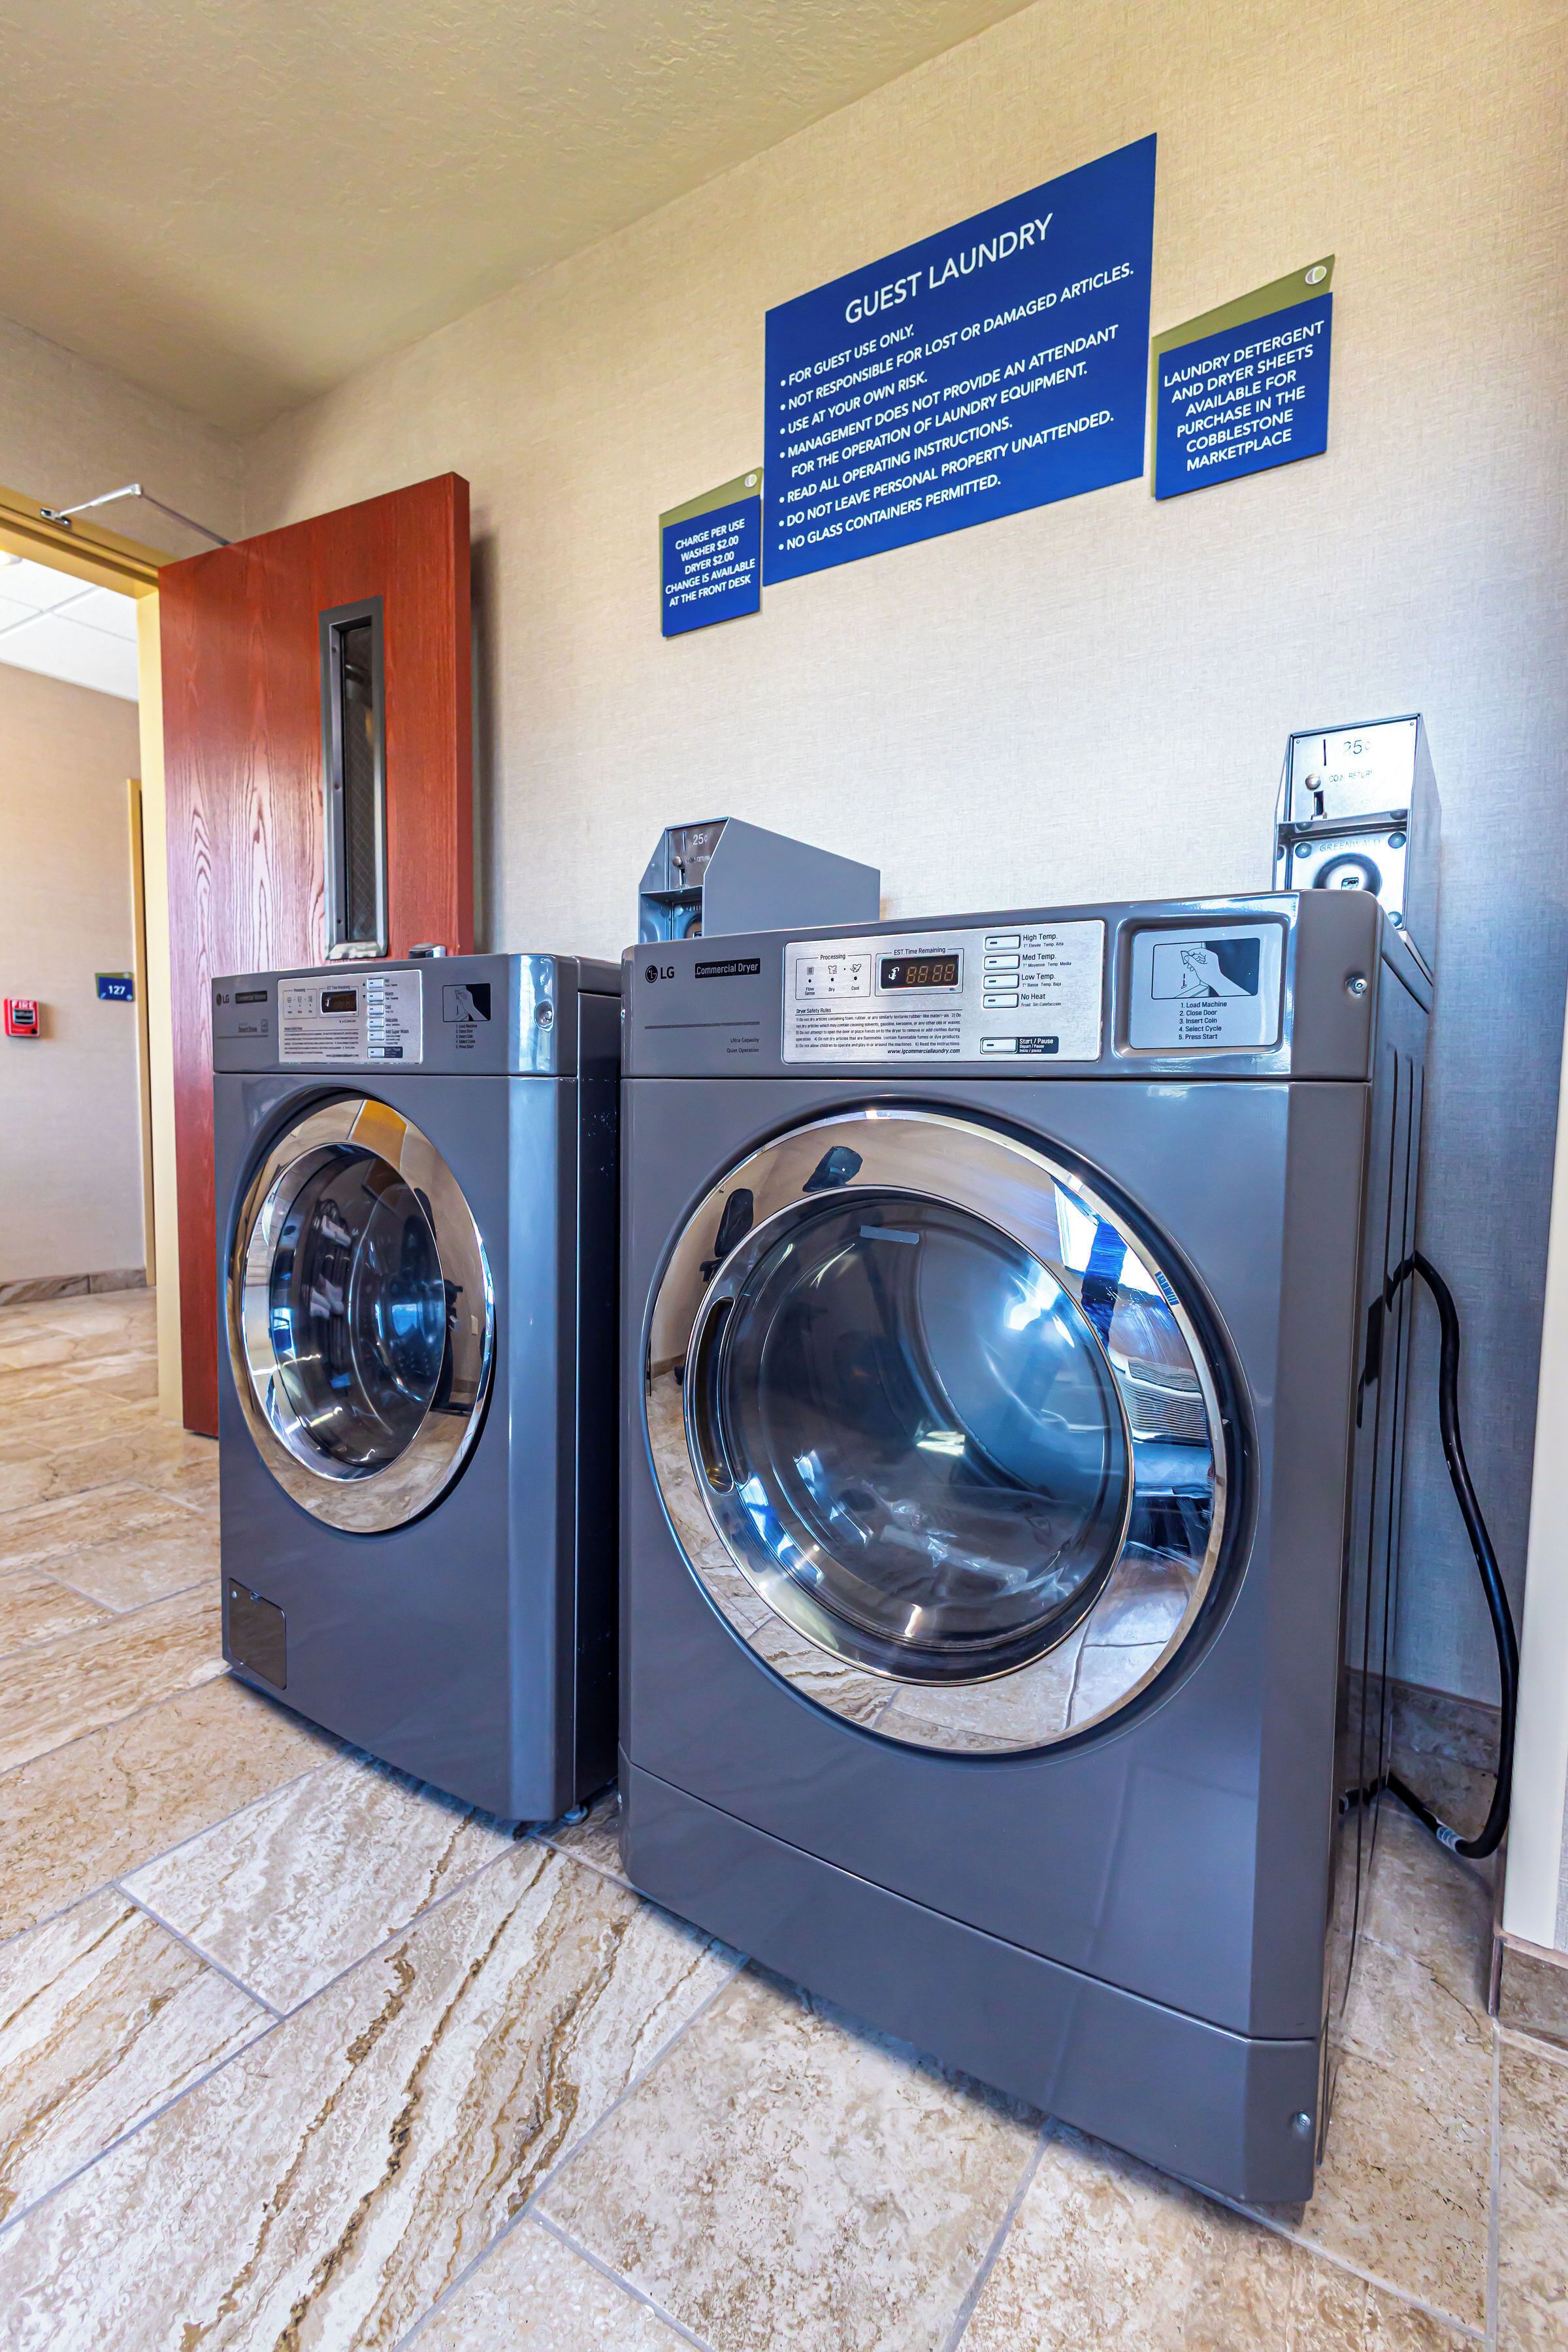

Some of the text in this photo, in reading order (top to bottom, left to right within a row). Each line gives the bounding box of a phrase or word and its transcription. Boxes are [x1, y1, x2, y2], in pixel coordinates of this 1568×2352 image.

[845, 213, 1053, 323] GUEST LAUNDRY
[789, 263, 1134, 410] NOT RESPONSIBLE FOR LOST OR DAMAGED ARTICLES.
[789, 324, 914, 385] FOR GUEST USE ONLY.
[1164, 320, 1324, 387] LAUNDRY DETERGENT
[788, 324, 1119, 458] MANAGEMENT DOES NOT PROVIDE AN ATTENDANT
[1171, 344, 1313, 403] AND DRYER SHEETS
[1186, 370, 1296, 417] AVAILABLE FOR
[789, 371, 928, 434] USE AT YOUR OWN RISK.
[792, 361, 1087, 478] FOR THE OPERATION OF LAUNDRY EQUIPMENT.
[1177, 385, 1305, 438] PURCHASE IN THE
[1186, 409, 1293, 452] COBBLESTONE
[1187, 429, 1292, 471] MARKETPLACE
[787, 416, 1013, 503] READ ALL OPERATING INSTRUCTIONS.
[787, 410, 1114, 527] DO NOT LEAVE PERSONAL PROPERTY UNATTENDED.
[676, 519, 745, 549] CHARGE PER USE
[787, 474, 1001, 550] NO GLASS CONTAINERS PERMITTED.
[681, 535, 739, 562] WASHER $2.00
[685, 551, 734, 575] DRYER $2.00
[665, 559, 755, 595] CHANGE IS AVAILABLE
[670, 574, 751, 607] AT THE FRONT DESK
[108, 985, 126, 995] 127
[661, 966, 675, 979] LG
[696, 963, 759, 975] Commercial Dryer
[222, 994, 230, 1004] LG
